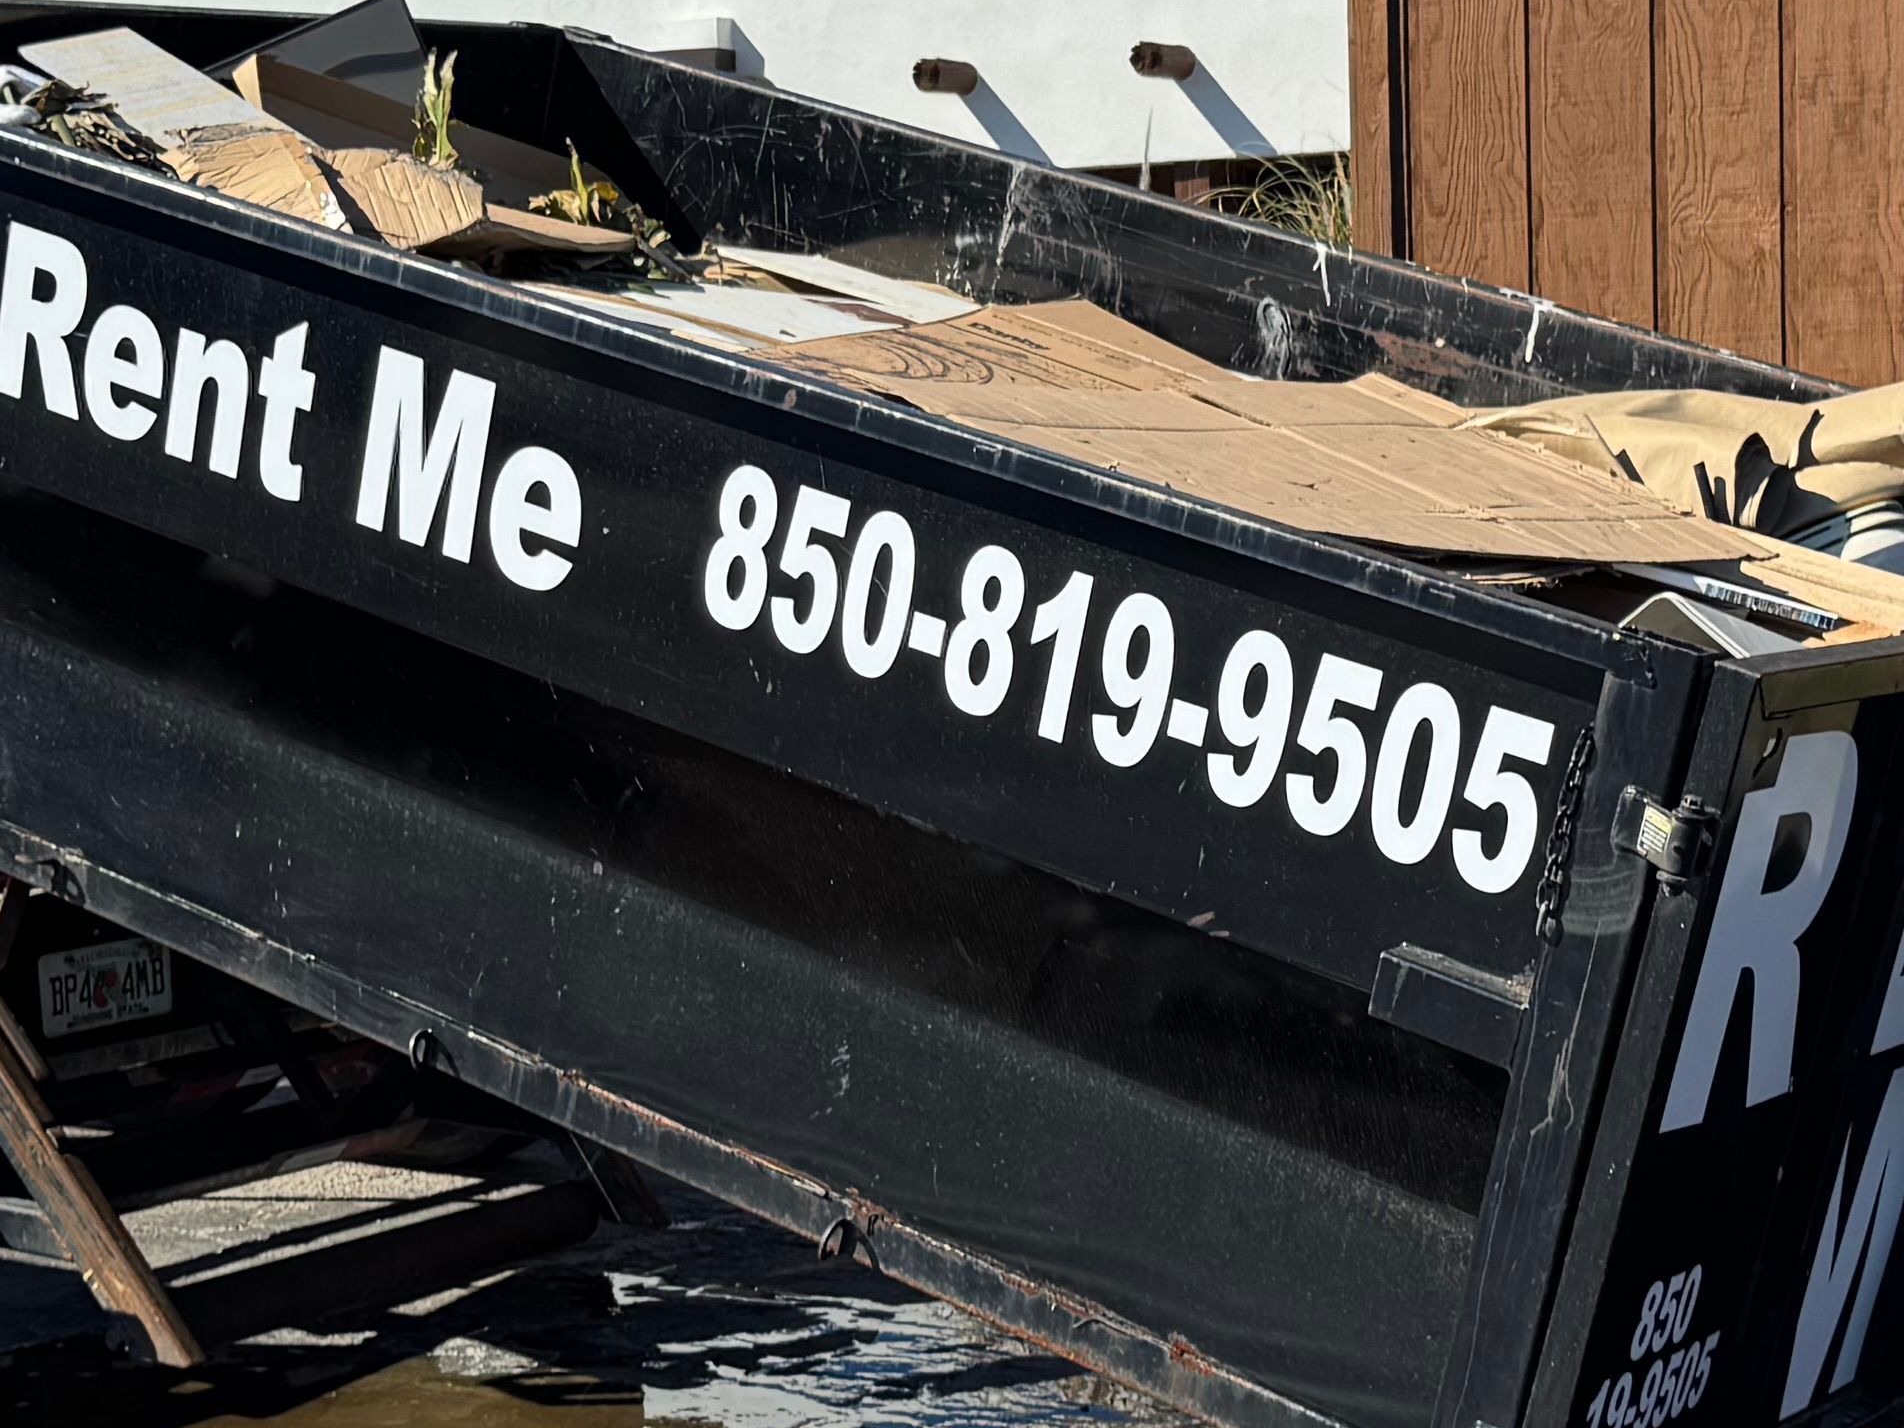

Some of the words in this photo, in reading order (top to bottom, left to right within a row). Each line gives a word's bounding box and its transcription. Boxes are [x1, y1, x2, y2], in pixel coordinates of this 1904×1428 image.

[356, 345, 583, 592] Me
[703, 464, 1555, 894] 850-819-9505
[1630, 1263, 1703, 1361] 850
